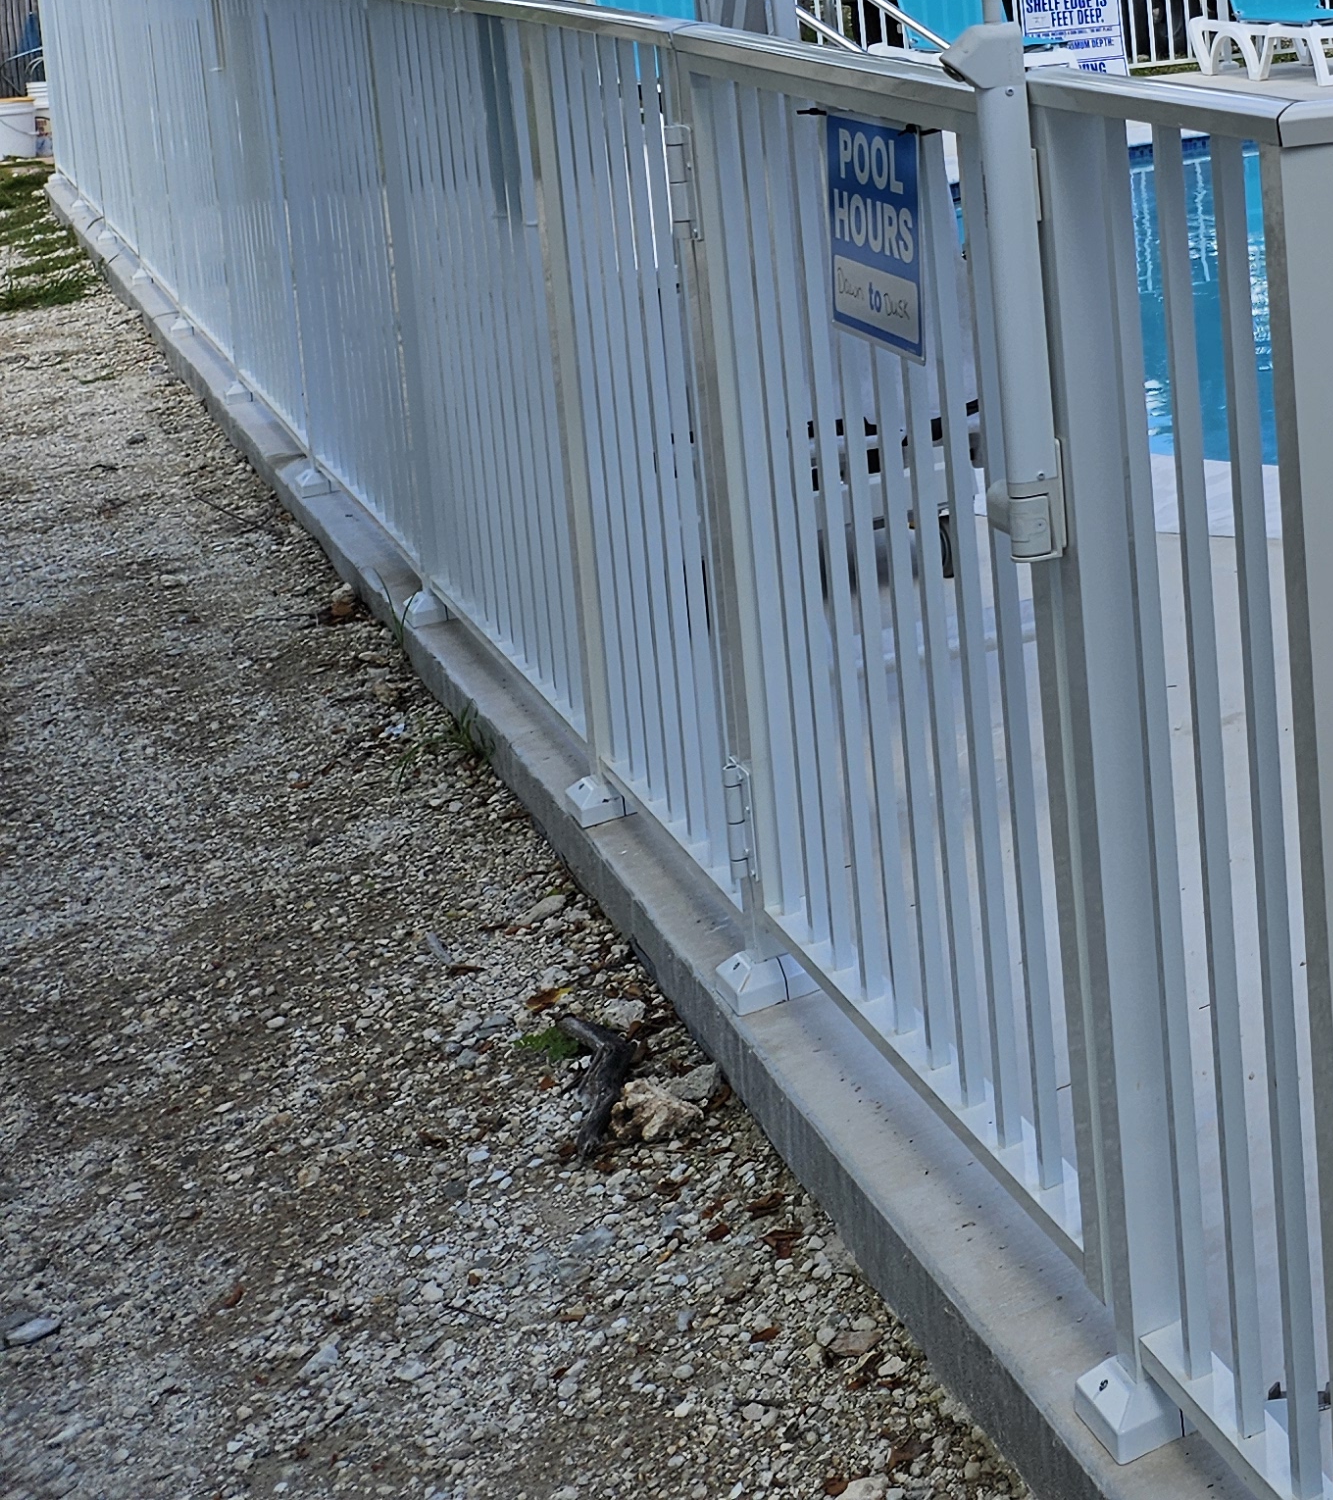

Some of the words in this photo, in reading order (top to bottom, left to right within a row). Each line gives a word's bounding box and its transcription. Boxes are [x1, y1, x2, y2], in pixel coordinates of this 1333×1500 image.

[1051, 10, 1073, 27] FEET
[1077, 8, 1105, 26] DEEP.
[838, 127, 904, 195] POOL
[833, 188, 913, 264] HOURS
[868, 282, 882, 313] to
